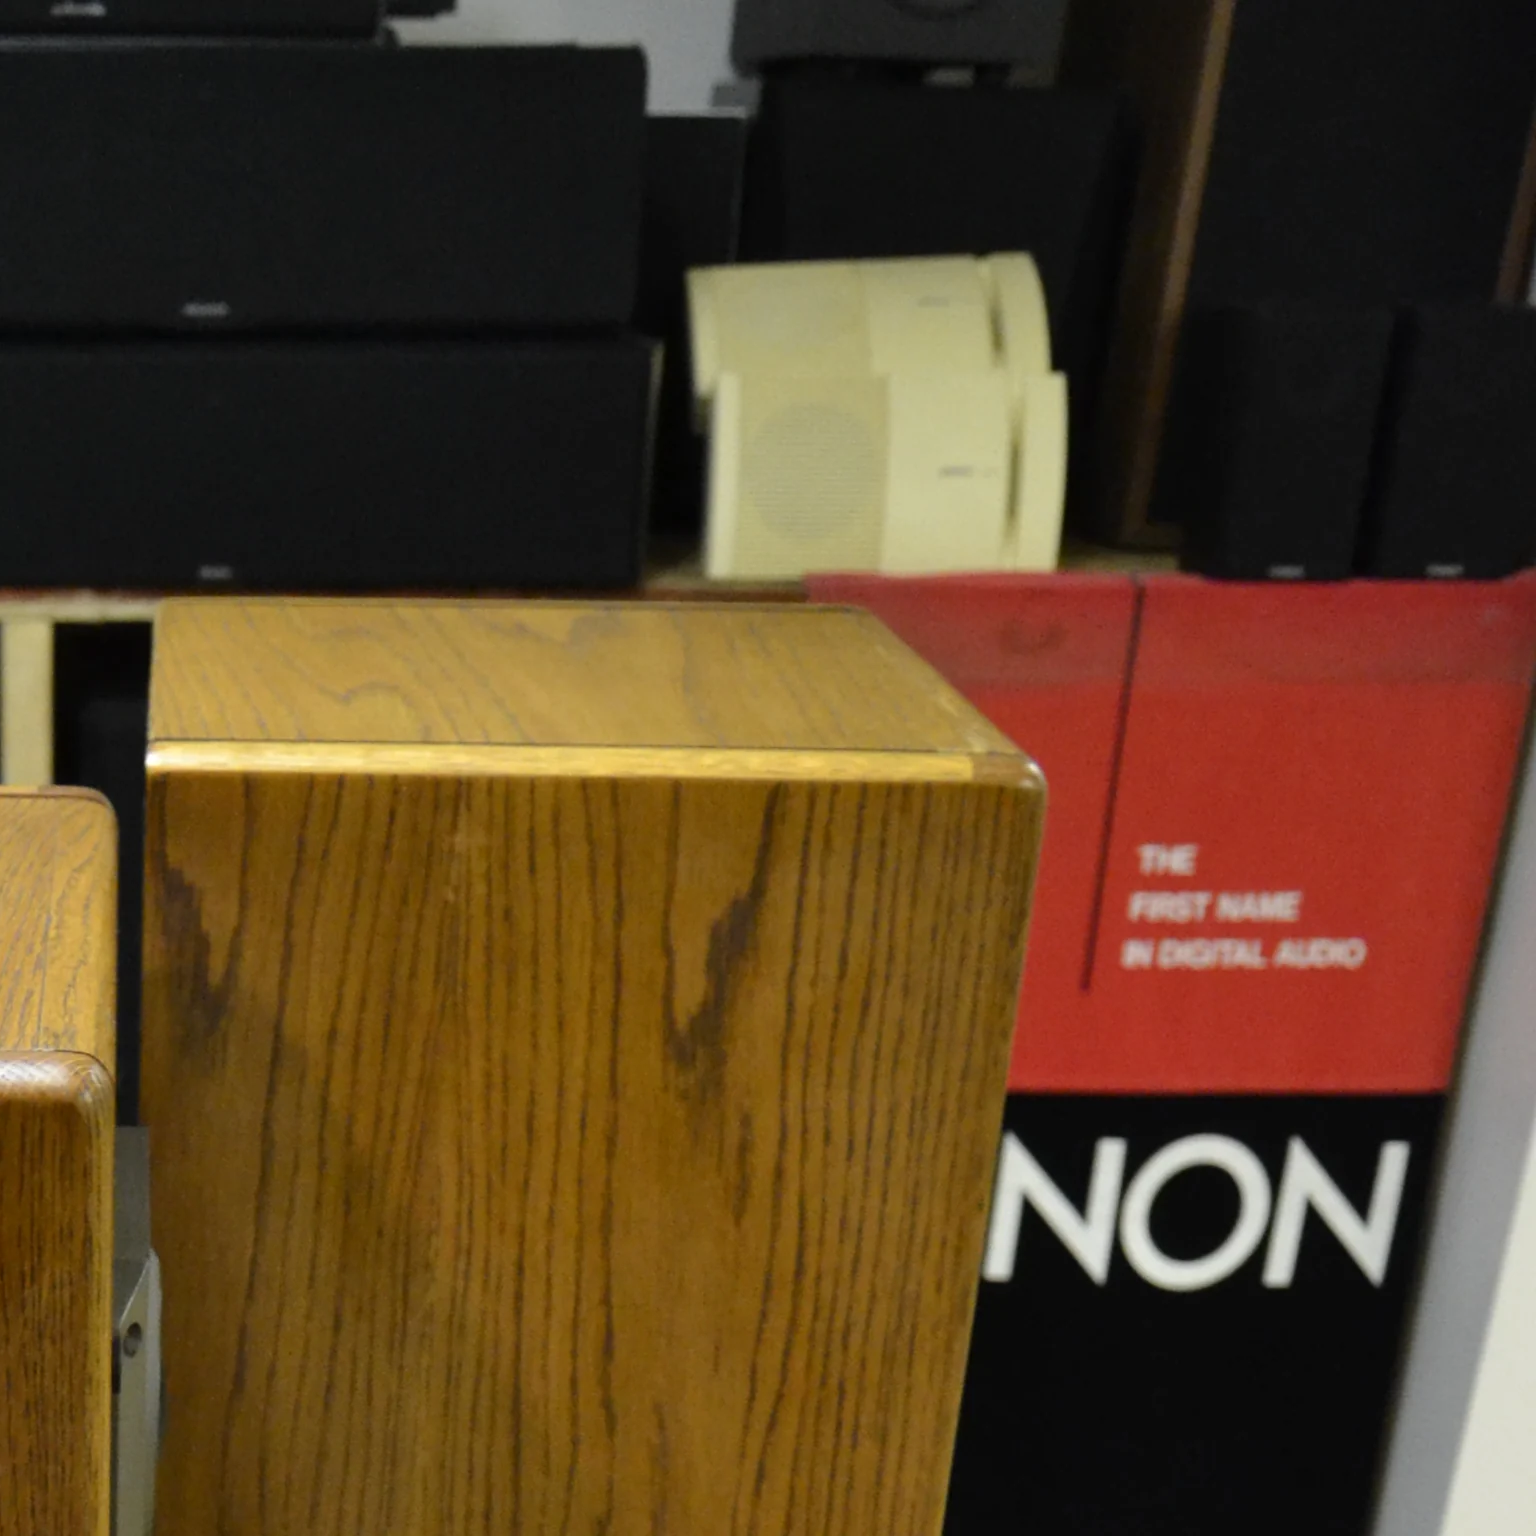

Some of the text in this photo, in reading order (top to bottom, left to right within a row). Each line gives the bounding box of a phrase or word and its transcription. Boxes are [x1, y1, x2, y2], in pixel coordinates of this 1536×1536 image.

[1139, 843, 1198, 876] THE
[1127, 890, 1302, 923] FIRST NAME
[1121, 936, 1367, 970] IN DIGITAL AUDIO
